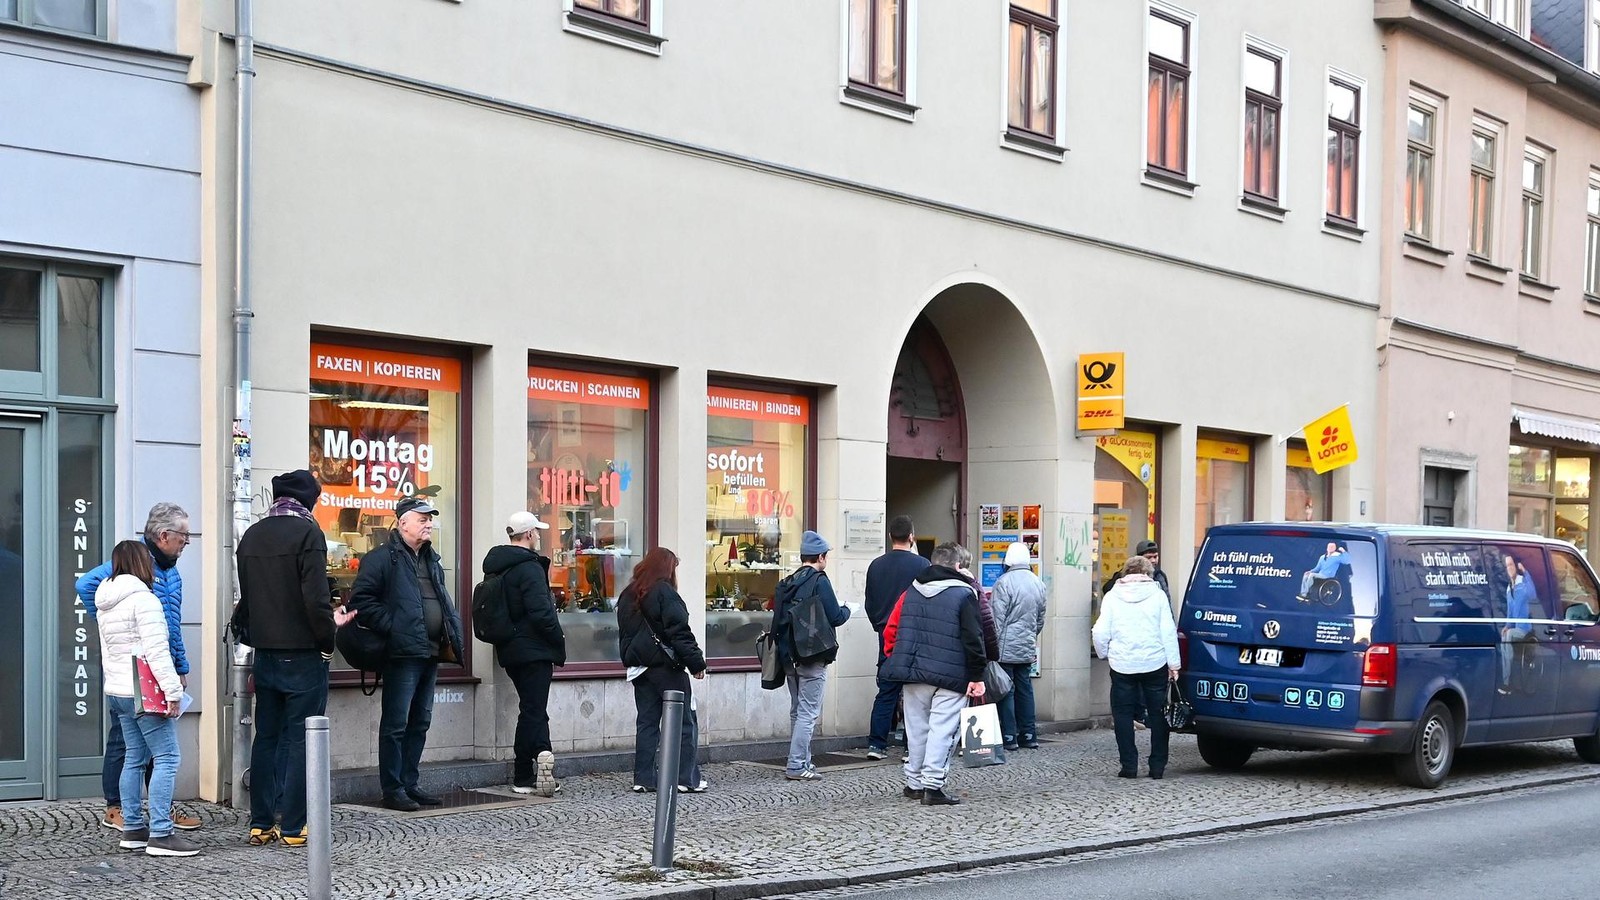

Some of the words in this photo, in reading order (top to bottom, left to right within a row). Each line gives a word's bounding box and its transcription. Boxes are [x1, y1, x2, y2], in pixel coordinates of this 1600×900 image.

[317, 355, 362, 373] FAXEN
[374, 361, 441, 381] KOPIEREN
[527, 377, 578, 393] RUCKEN
[587, 383, 640, 399] SCANNEN
[766, 402, 801, 416] BINDEN
[1083, 410, 1115, 418] DHL
[323, 429, 434, 472] Montag
[1318, 443, 1348, 460] LOTTO
[707, 449, 764, 473] sofort
[353, 464, 414, 496] 15%
[723, 471, 766, 487] befüllen
[746, 489, 794, 518] 80%
[754, 515, 778, 526] sparen
[1213, 552, 1227, 562] Ich
[1228, 551, 1249, 563] fühl
[1249, 553, 1274, 564] mich
[1421, 552, 1435, 566] Ich
[1434, 552, 1452, 567] fühl
[1452, 552, 1471, 567] mich
[1211, 564, 1234, 575] stark
[1235, 565, 1253, 576] mit
[1254, 566, 1292, 578] Jüttner.
[1425, 570, 1446, 586] stark
[1446, 571, 1461, 585] mit
[1461, 571, 1488, 585] Jüttner.
[1203, 610, 1237, 623] JÜTTNER
